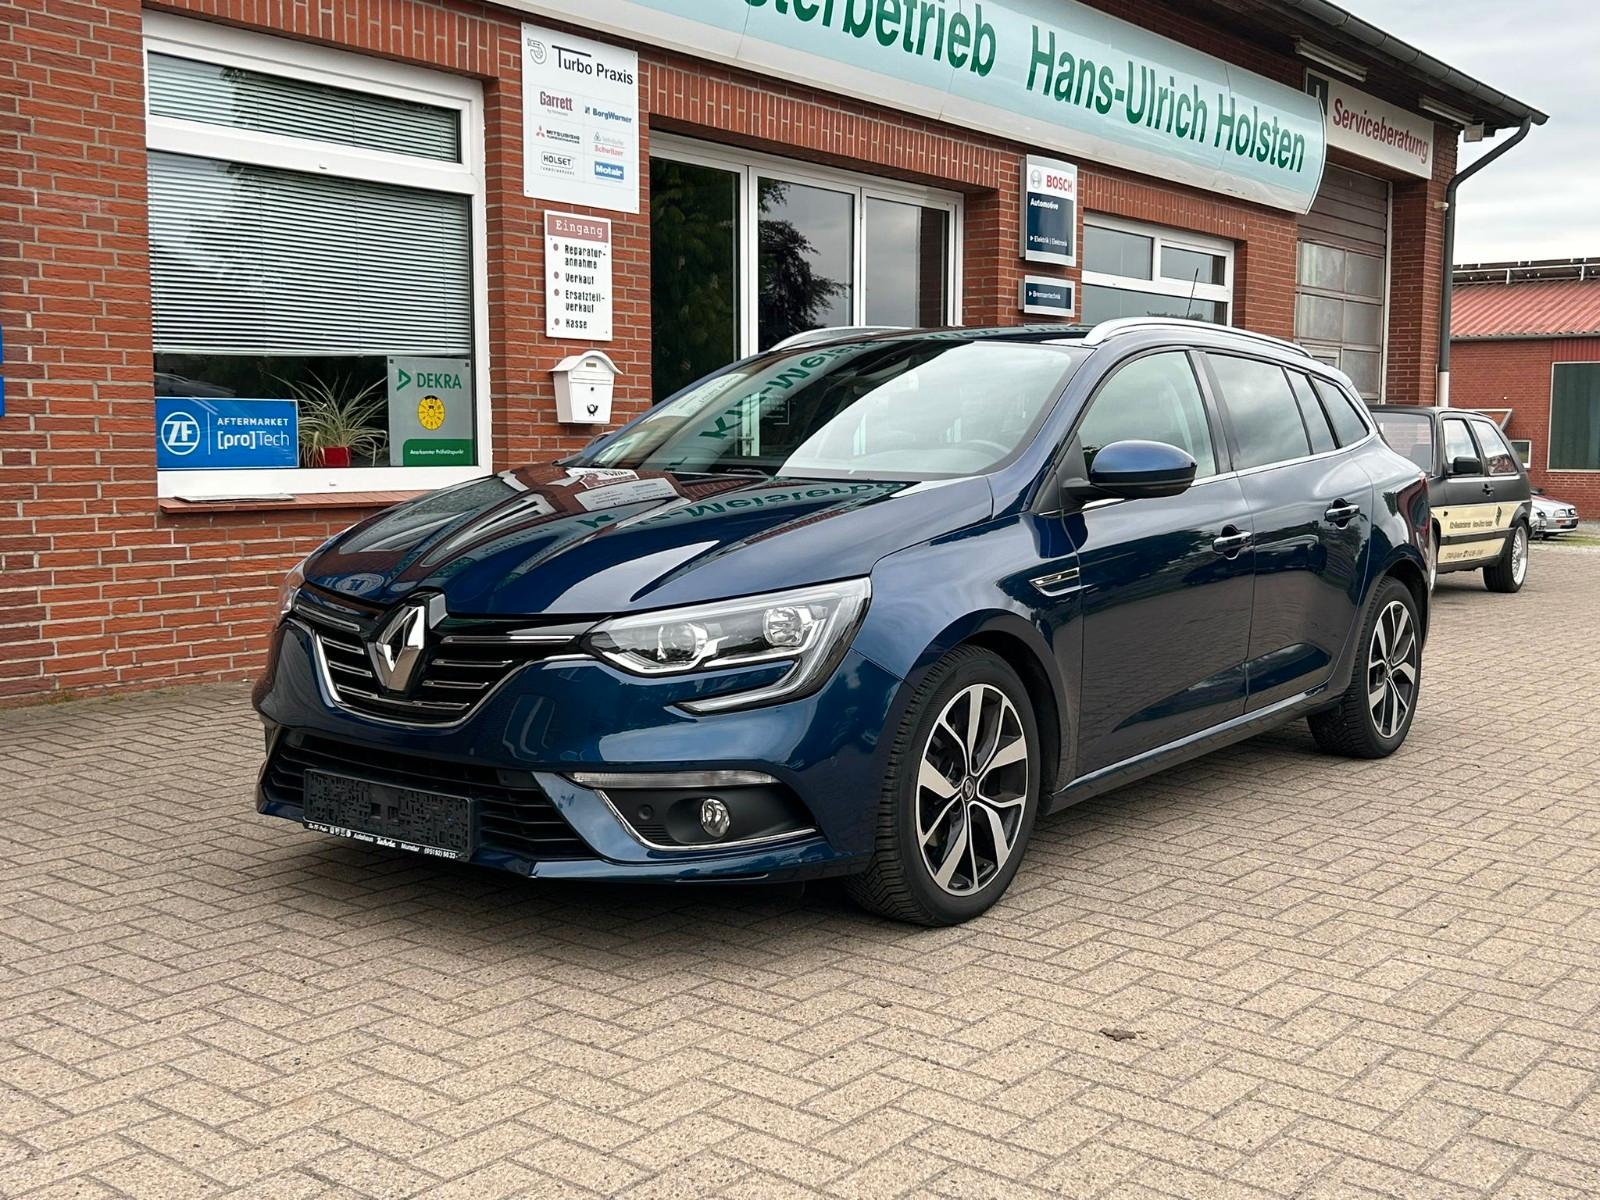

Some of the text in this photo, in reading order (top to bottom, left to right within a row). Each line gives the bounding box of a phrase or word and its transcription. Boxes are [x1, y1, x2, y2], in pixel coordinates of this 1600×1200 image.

[551, 44, 634, 86] Turbo Praxis
[540, 90, 574, 112] Garrett
[1026, 24, 1208, 143] Hans-Ulrich
[1214, 92, 1305, 173] Holsten
[592, 107, 633, 124] BorgWarner
[1332, 97, 1430, 165] Serviceberatung
[543, 154, 572, 167] HOLSET
[1046, 174, 1073, 194] BOSCH
[555, 219, 603, 238] Eingang
[564, 244, 607, 258] Reparatur-
[564, 257, 598, 270] annahme
[565, 272, 595, 285] Verkauf
[565, 289, 606, 303] Ersatzteil-
[565, 318, 588, 330] Kasse
[416, 372, 462, 390] DEKRA
[216, 417, 289, 427] AFTERMARKET
[217, 430, 290, 450] [pro]Tech
